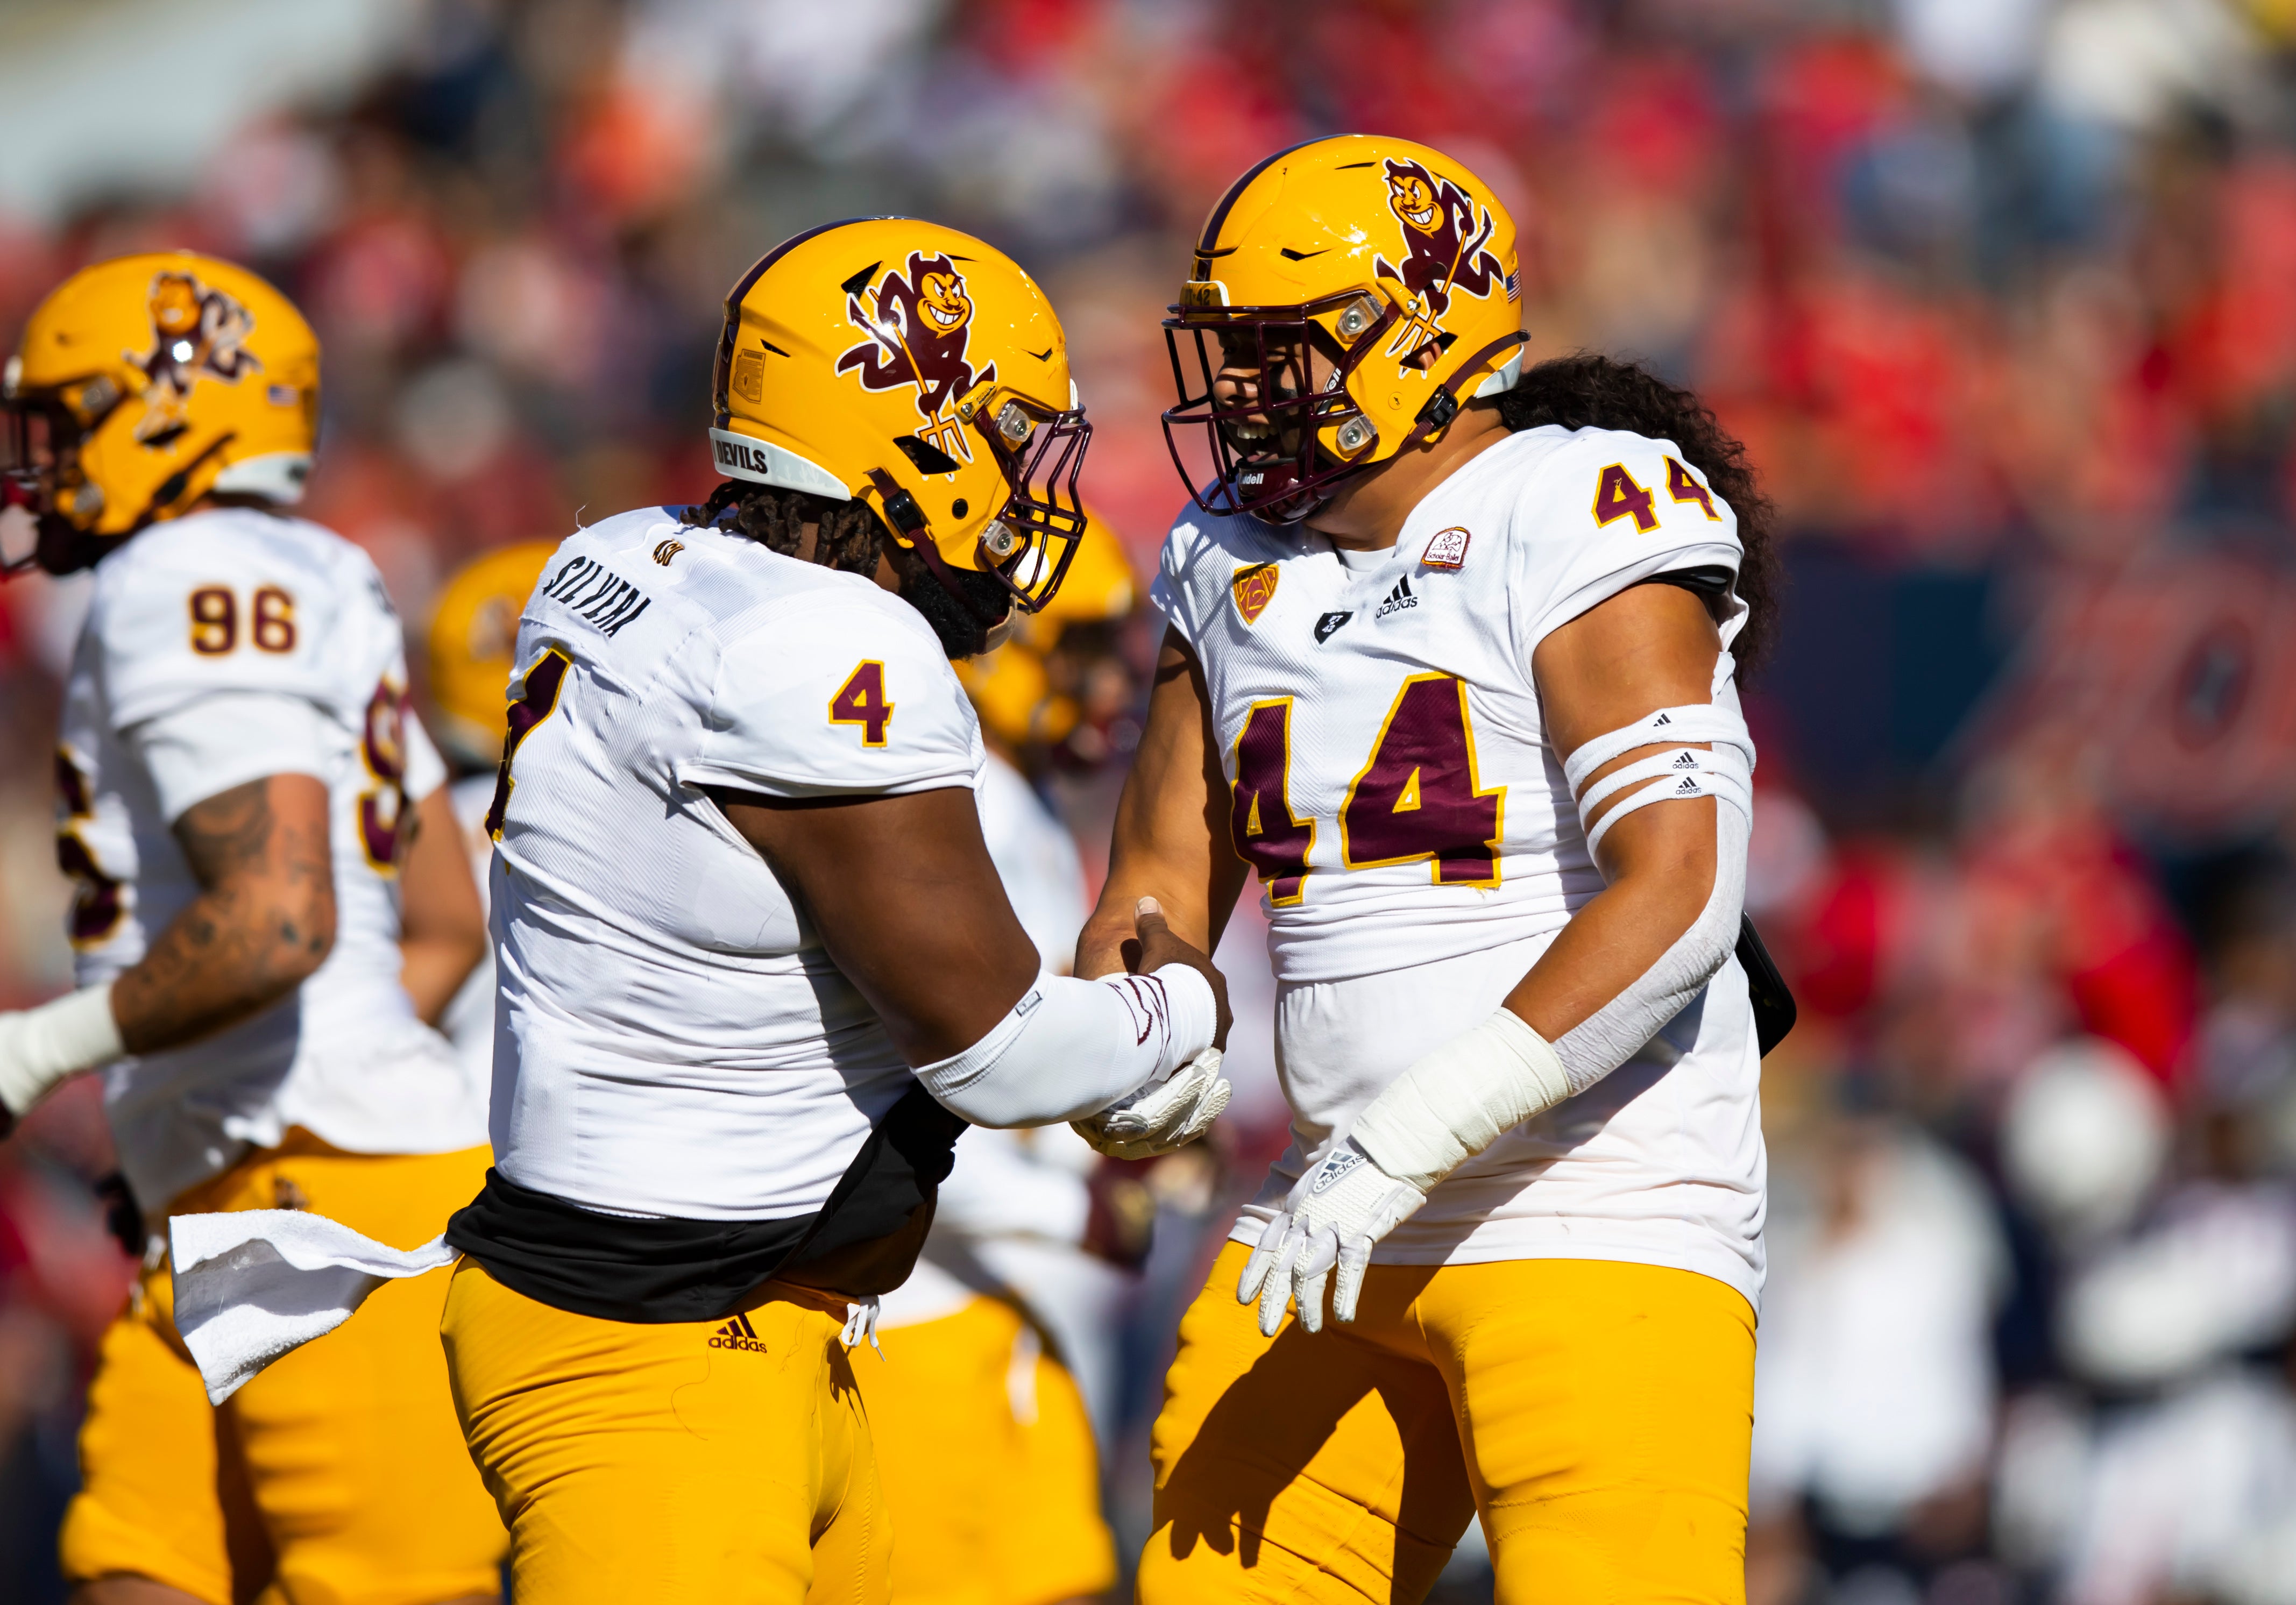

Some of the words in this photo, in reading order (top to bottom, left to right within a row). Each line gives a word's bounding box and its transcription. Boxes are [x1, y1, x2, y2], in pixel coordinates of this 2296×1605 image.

[715, 440, 768, 474] DEVILS
[1591, 454, 1723, 535] 44
[543, 556, 651, 638] SILVERA
[1245, 590, 1265, 612] 12
[1376, 596, 1418, 619] adidas
[188, 583, 297, 657] 96
[828, 659, 895, 748] 4
[1673, 761, 1699, 769] adidas
[1230, 671, 1508, 908] 44
[1676, 786, 1702, 795] adidas
[1316, 1155, 1364, 1190] adidas
[708, 1334, 767, 1354] adidas
